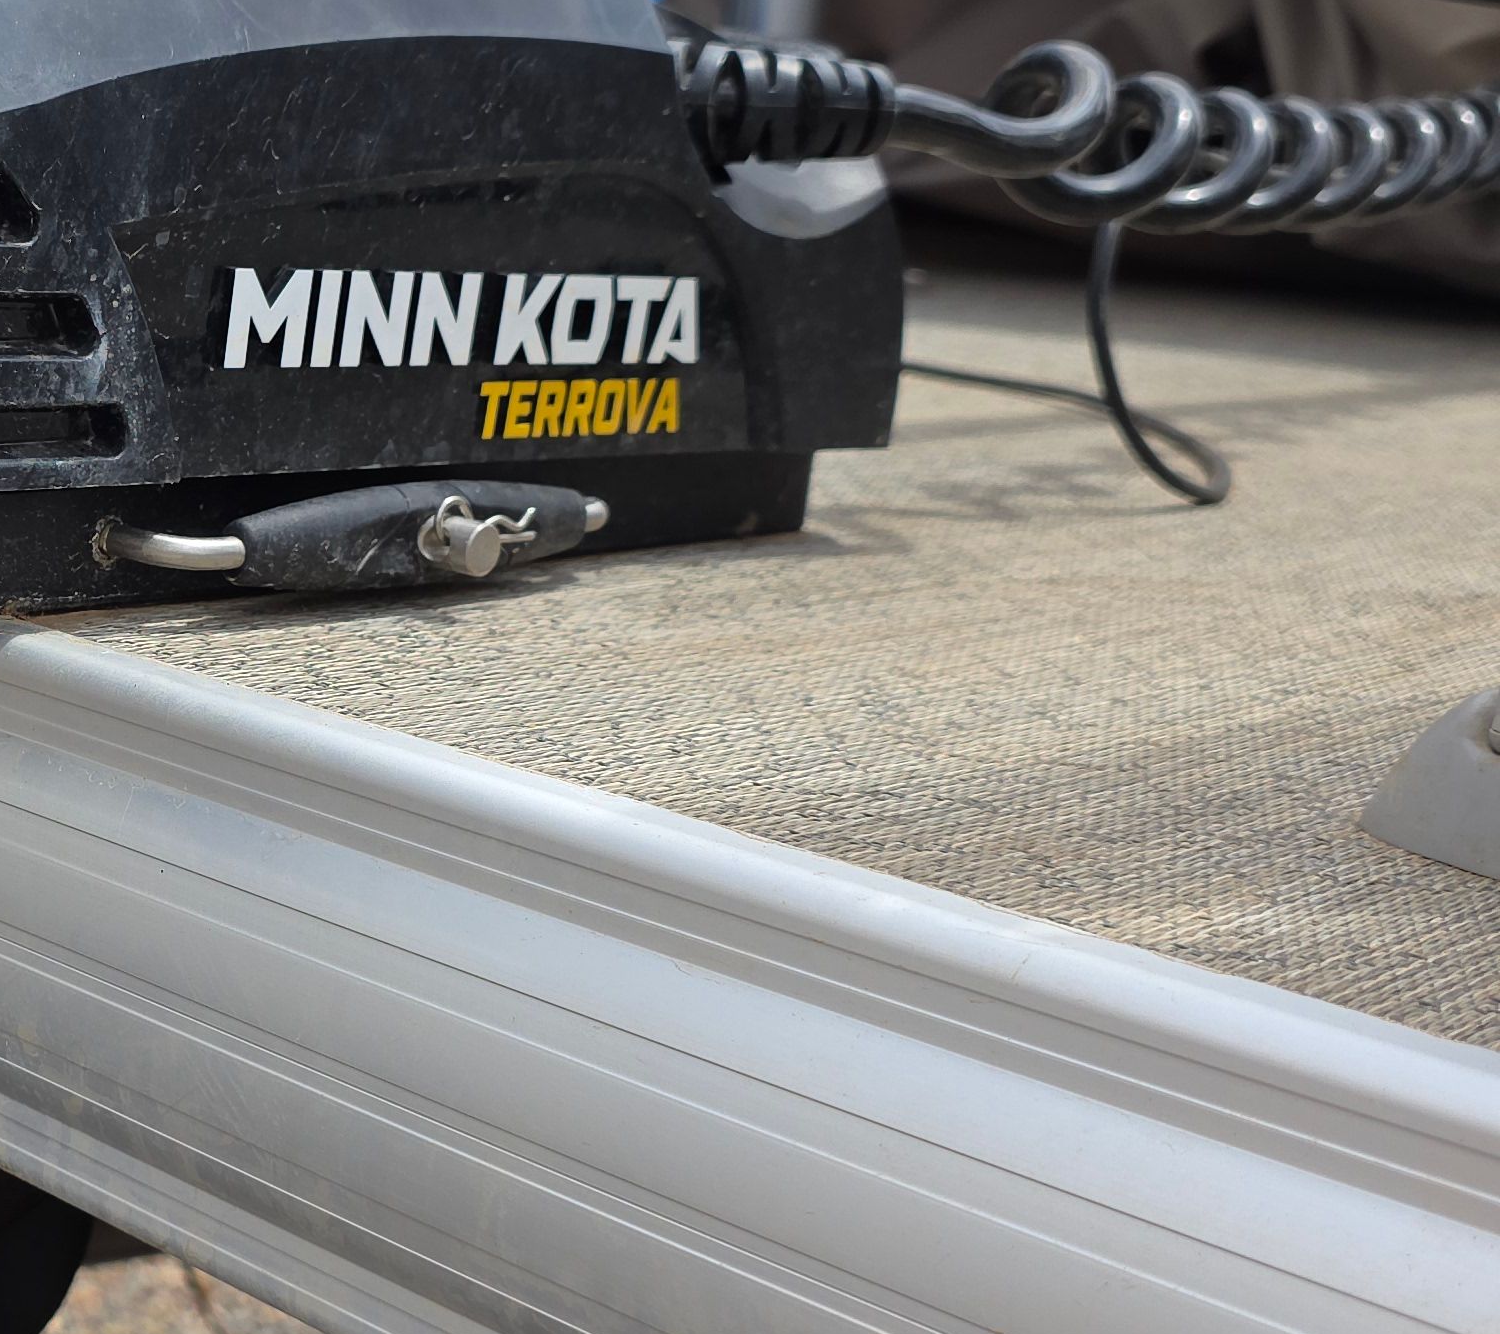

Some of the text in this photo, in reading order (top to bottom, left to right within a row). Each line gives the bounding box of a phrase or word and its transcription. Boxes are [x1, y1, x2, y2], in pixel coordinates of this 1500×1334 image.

[223, 267, 700, 368] MINN KOTA
[479, 377, 680, 440] TERROVA
